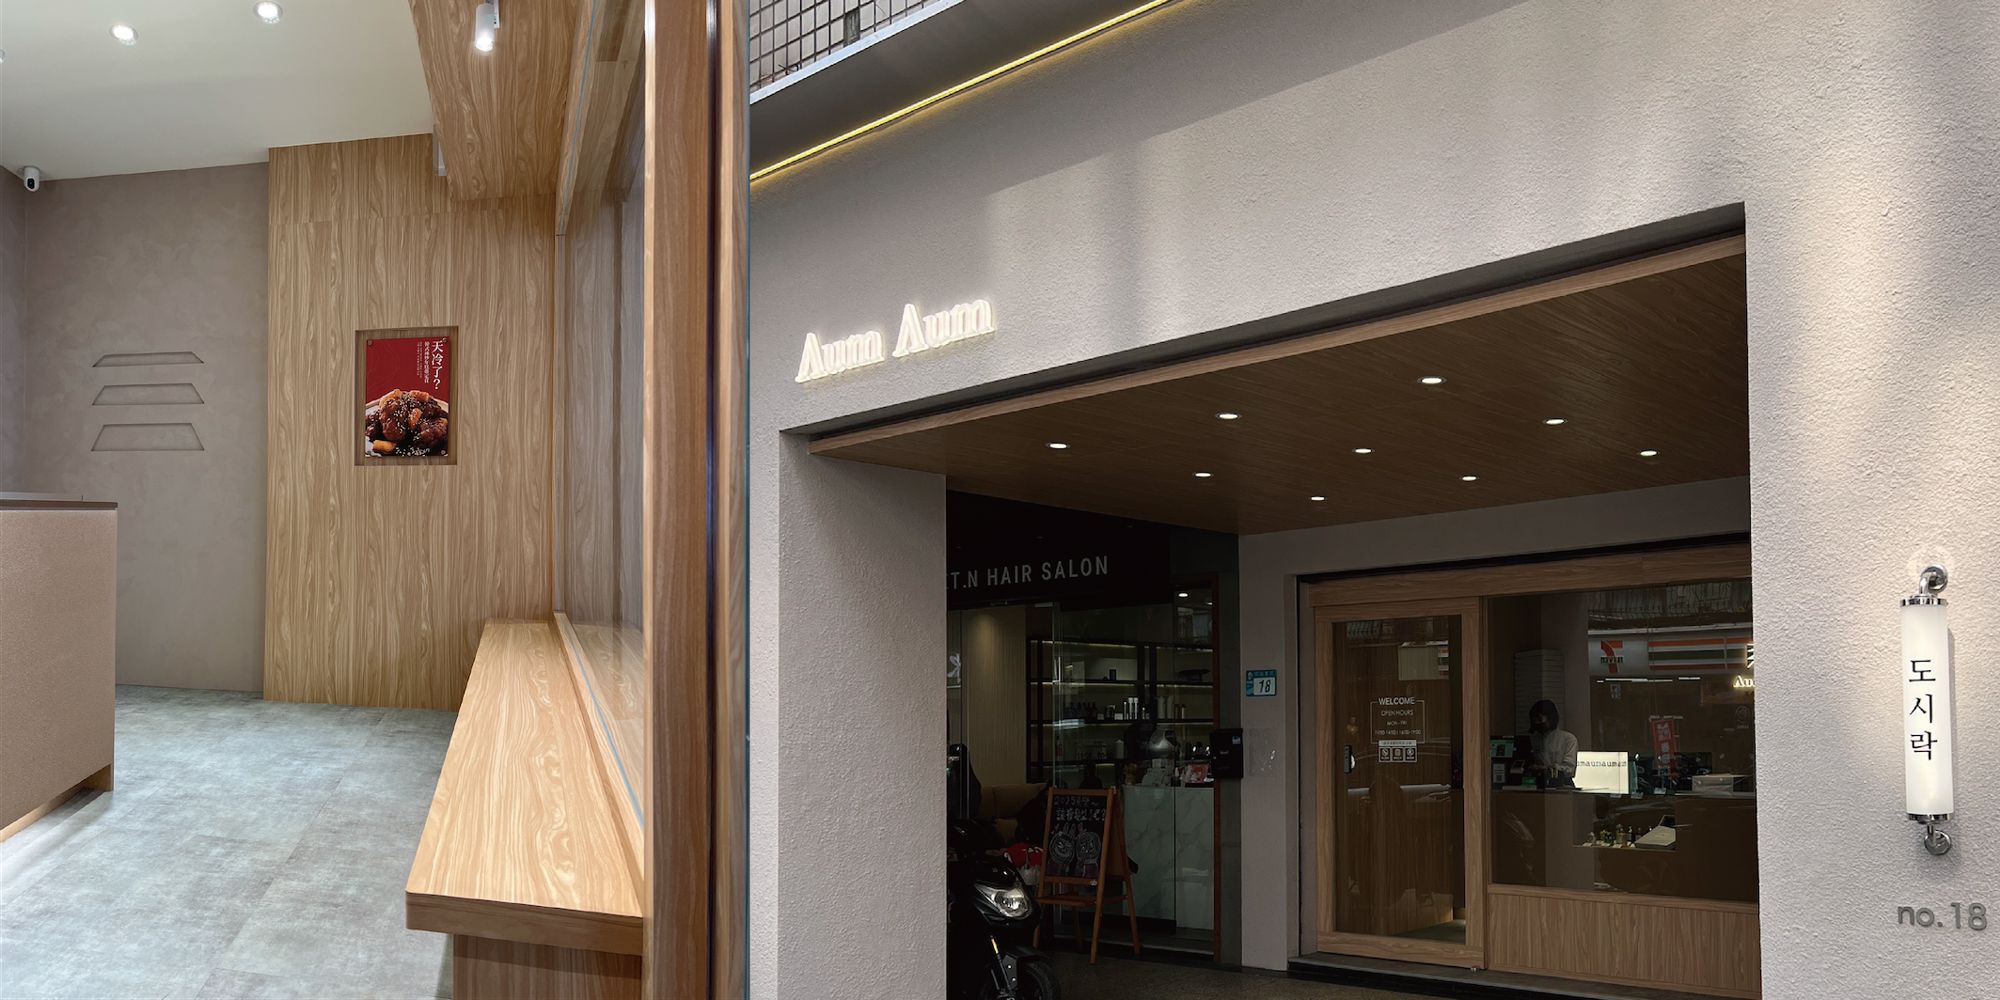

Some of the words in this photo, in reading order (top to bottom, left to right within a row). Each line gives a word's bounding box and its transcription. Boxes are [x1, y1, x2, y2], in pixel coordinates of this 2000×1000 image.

[795, 331, 885, 383] Aum
[892, 299, 996, 357] Aum
[946, 569, 979, 590] T.N
[986, 564, 1033, 587] HAIR
[1041, 555, 1109, 581] SALON
[1258, 679, 1272, 694] 18
[1732, 675, 1755, 688] Au
[1378, 696, 1416, 706] WELCOME
[1908, 657, 1939, 762] 도시락
[1897, 902, 1988, 931] no.18
